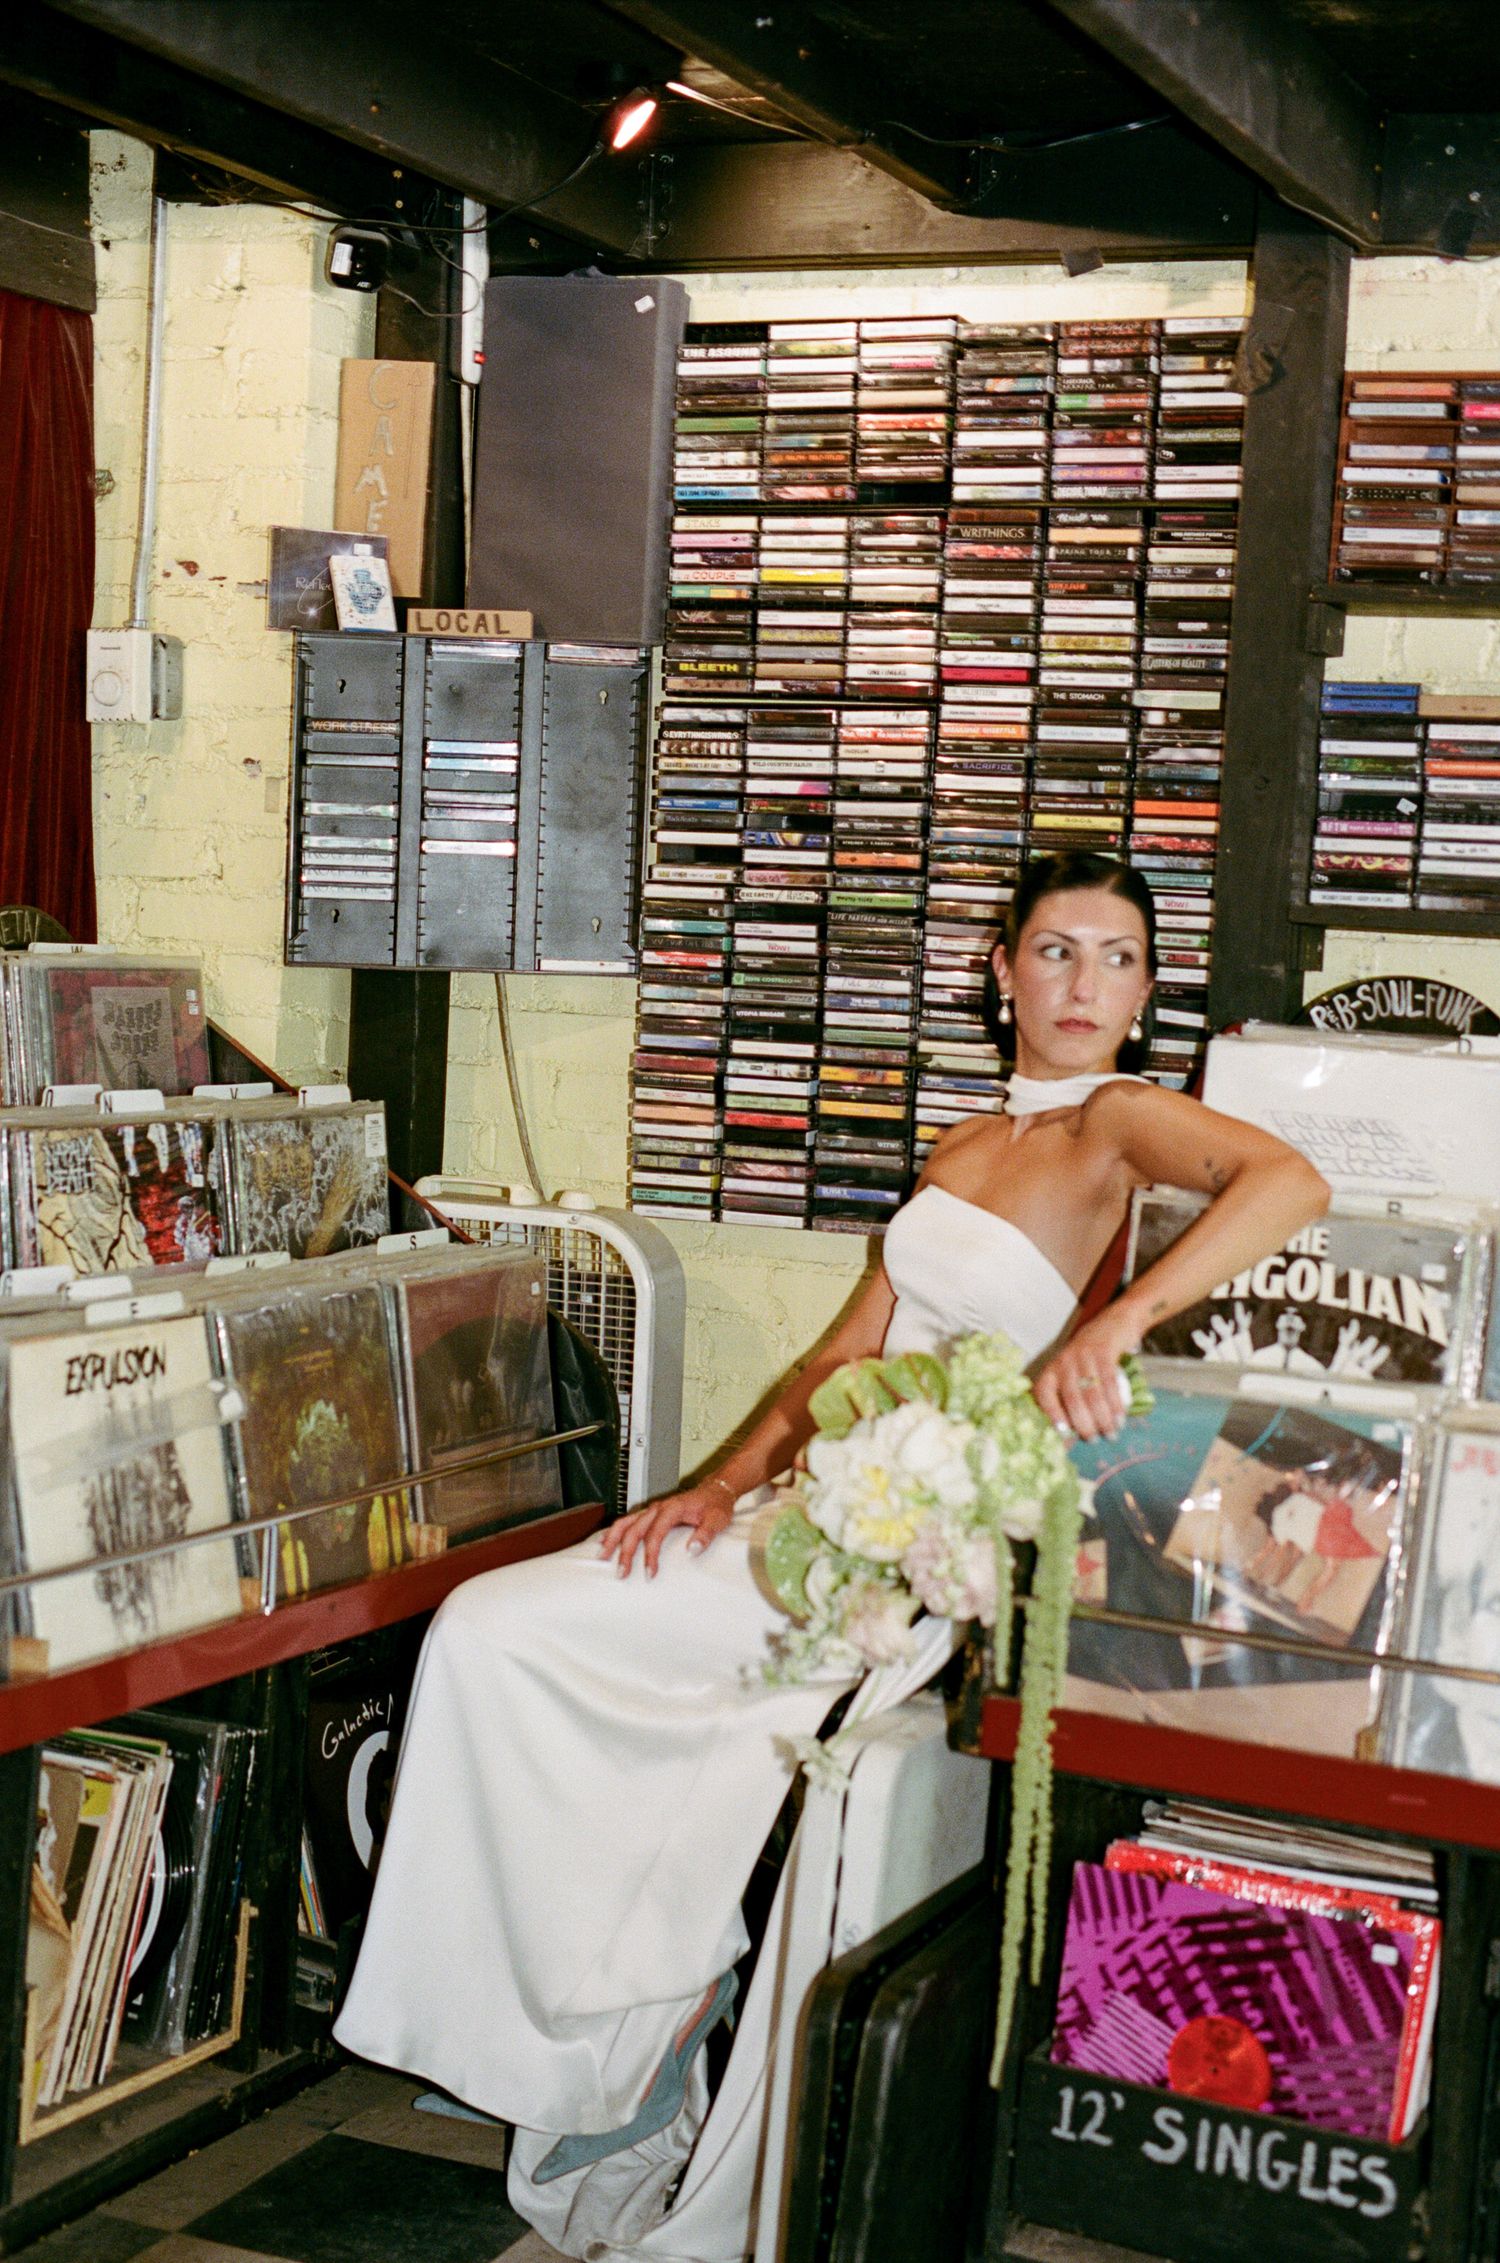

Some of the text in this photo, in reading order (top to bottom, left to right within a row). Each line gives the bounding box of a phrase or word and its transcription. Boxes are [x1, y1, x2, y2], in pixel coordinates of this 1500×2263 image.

[960, 527, 1026, 538] WRITHINGS
[416, 610, 511, 635] LOCAL
[962, 763, 1013, 771] SACRIFICE
[409, 1235, 417, 1251] S
[1285, 1225, 1330, 1257] HE
[65, 1346, 167, 1395] EXPULSION
[1142, 2106, 1398, 2218] SINGLES
